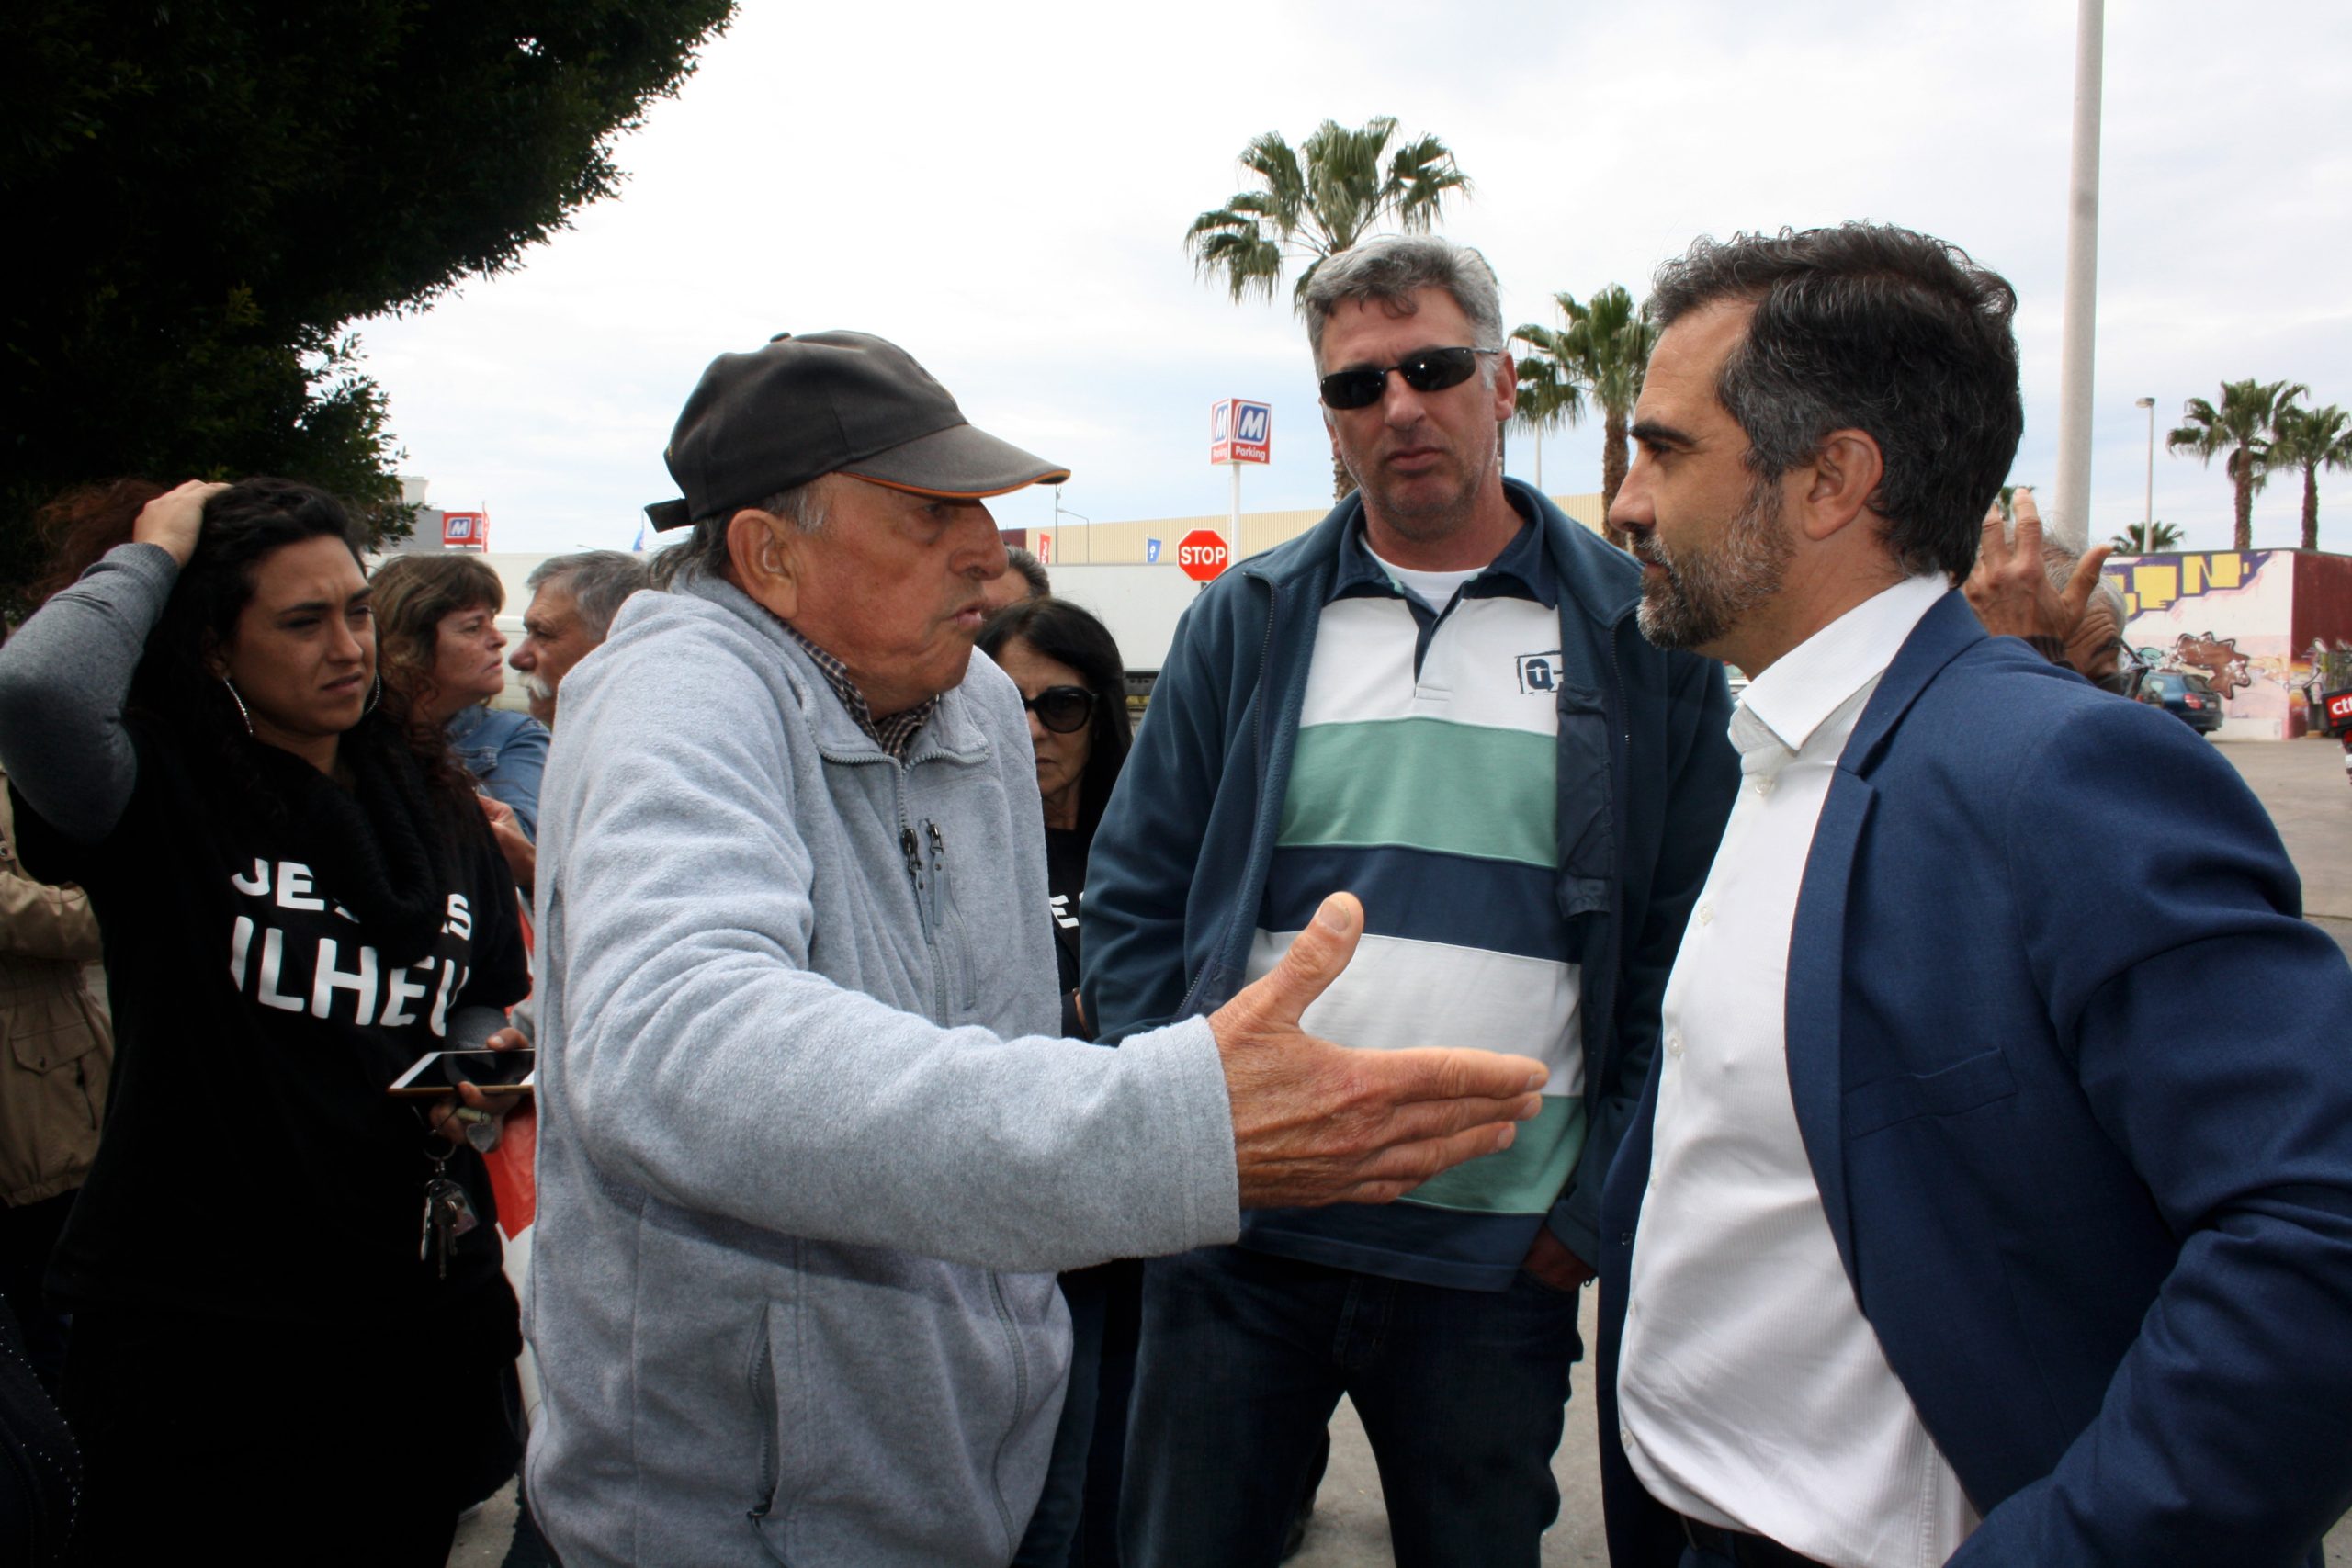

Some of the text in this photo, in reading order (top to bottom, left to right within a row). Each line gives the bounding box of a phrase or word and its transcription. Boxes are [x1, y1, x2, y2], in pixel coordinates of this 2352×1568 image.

[1239, 410, 1265, 439] M
[1235, 445, 1266, 461] Parking
[451, 520, 468, 535] M
[1180, 546, 1227, 565] STOP
[232, 857, 325, 911] JE
